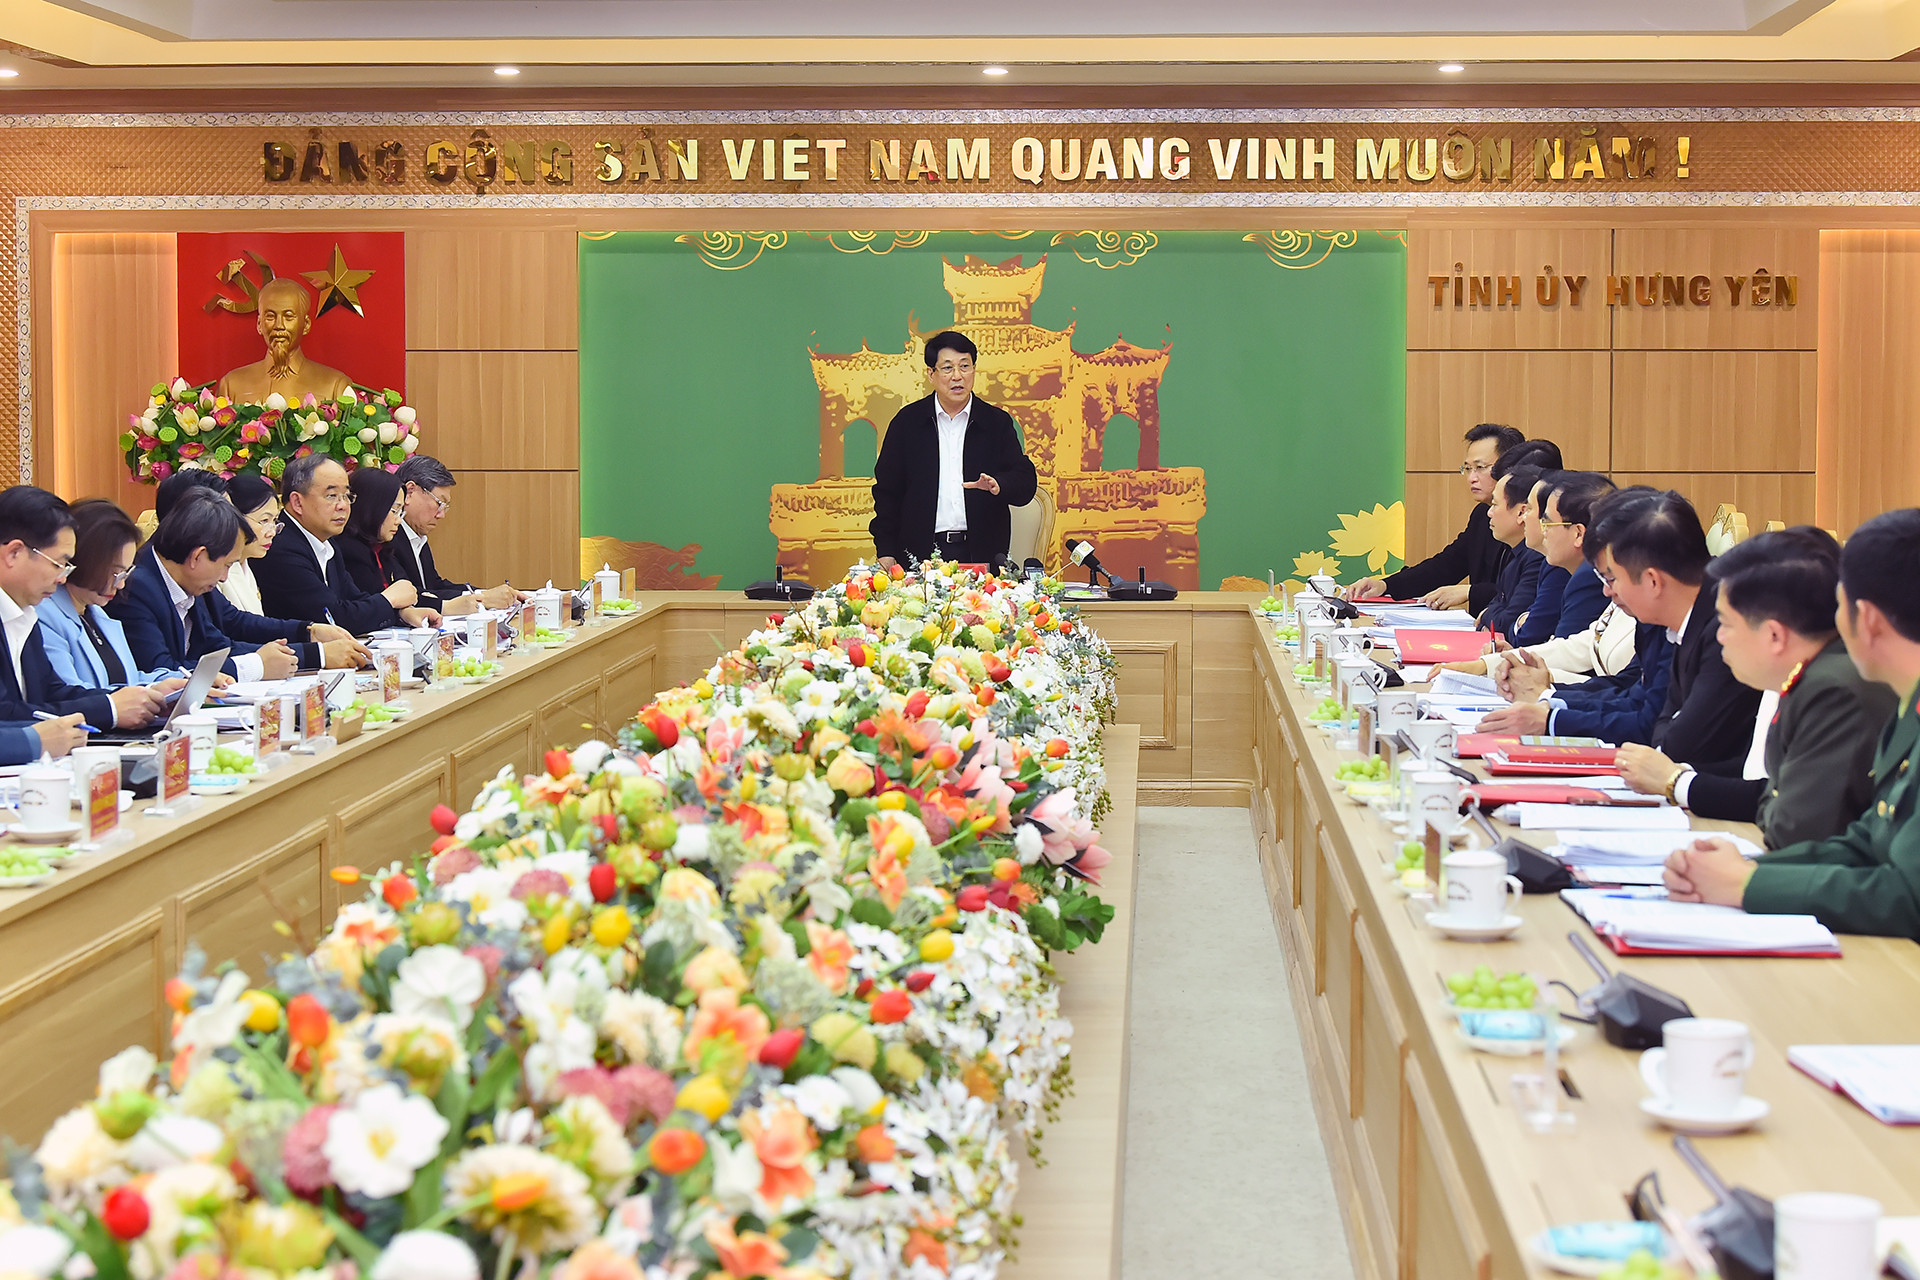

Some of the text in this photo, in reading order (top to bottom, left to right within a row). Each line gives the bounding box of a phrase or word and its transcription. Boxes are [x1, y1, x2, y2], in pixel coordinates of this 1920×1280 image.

[261, 128, 405, 182] ĐẢNG
[426, 129, 572, 195] CỘNG
[594, 127, 698, 181] SẢN
[721, 133, 847, 191] VIỆT
[870, 138, 990, 180] NAM
[1011, 137, 1190, 185] QUANG
[1207, 138, 1335, 180] VINH
[1356, 130, 1512, 181] MUÔN
[1534, 127, 1655, 180] NĂM
[1428, 262, 1798, 306] TỈNH ỦY HƯNG YÊN
